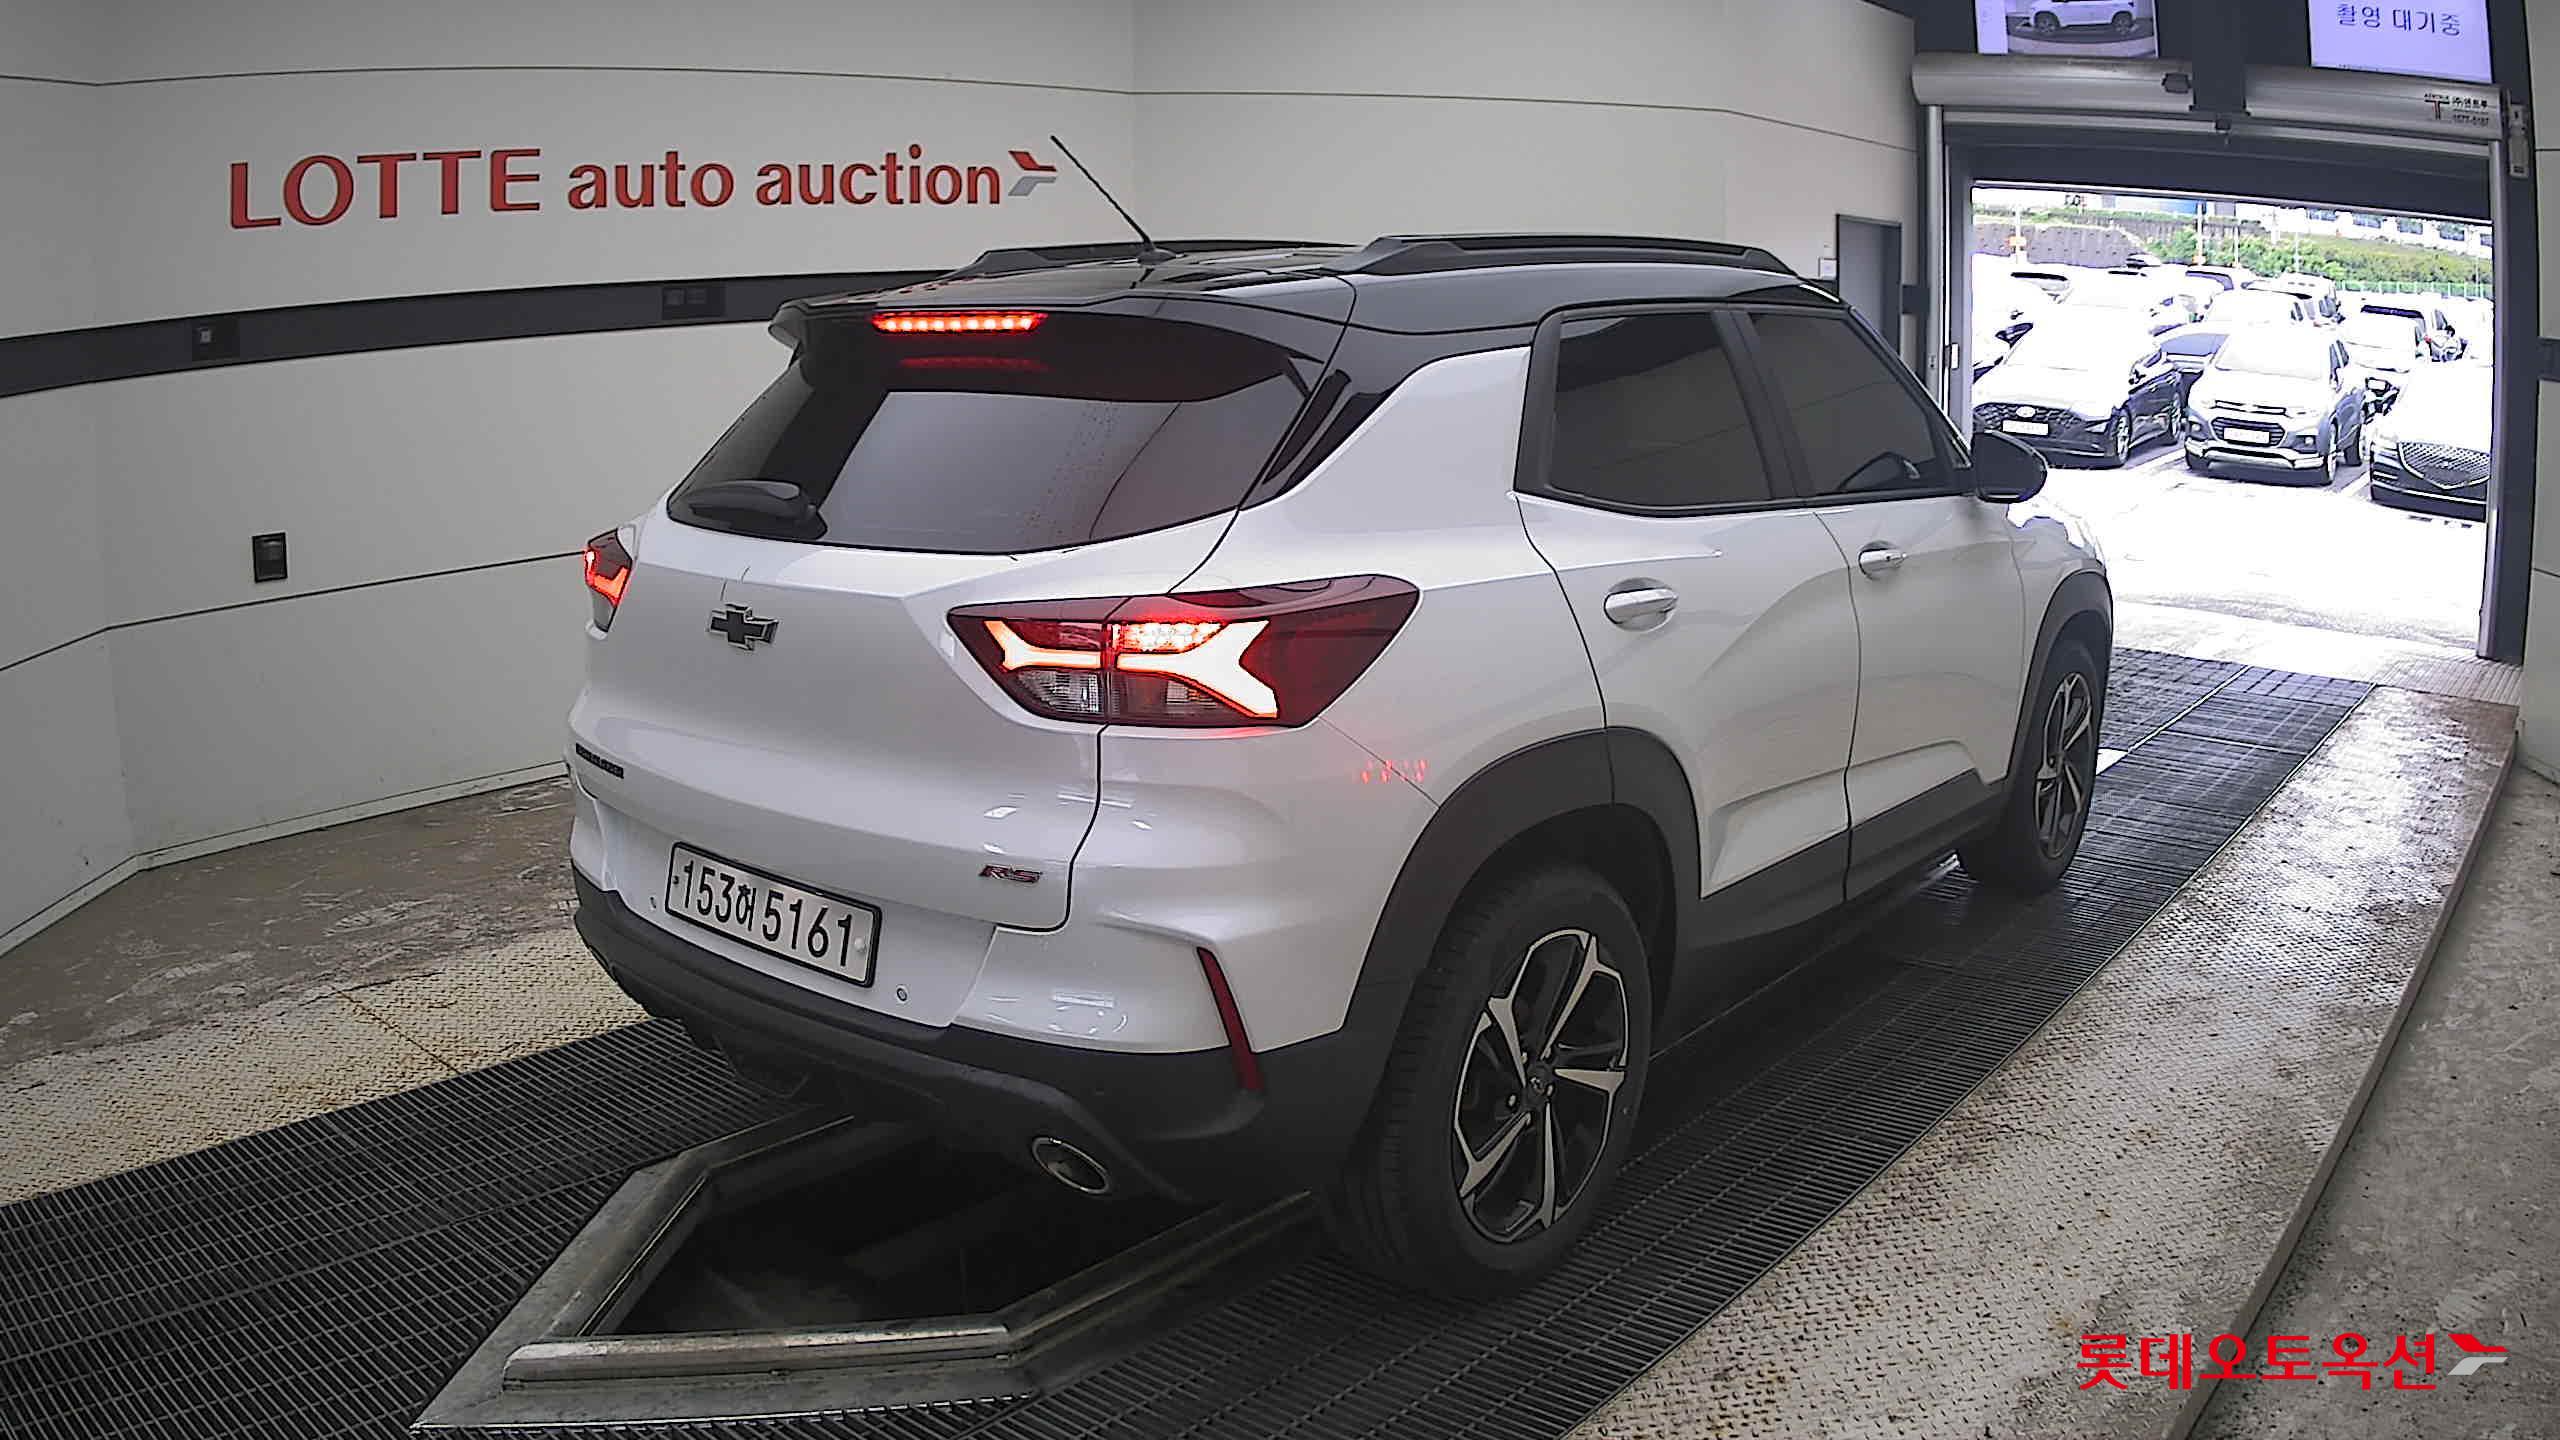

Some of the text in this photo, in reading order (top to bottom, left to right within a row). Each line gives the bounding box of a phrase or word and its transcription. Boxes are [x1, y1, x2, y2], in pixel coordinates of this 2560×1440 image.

[2392, 9, 2461, 36] 대기중
[230, 144, 1001, 230] LOTTE auto auction
